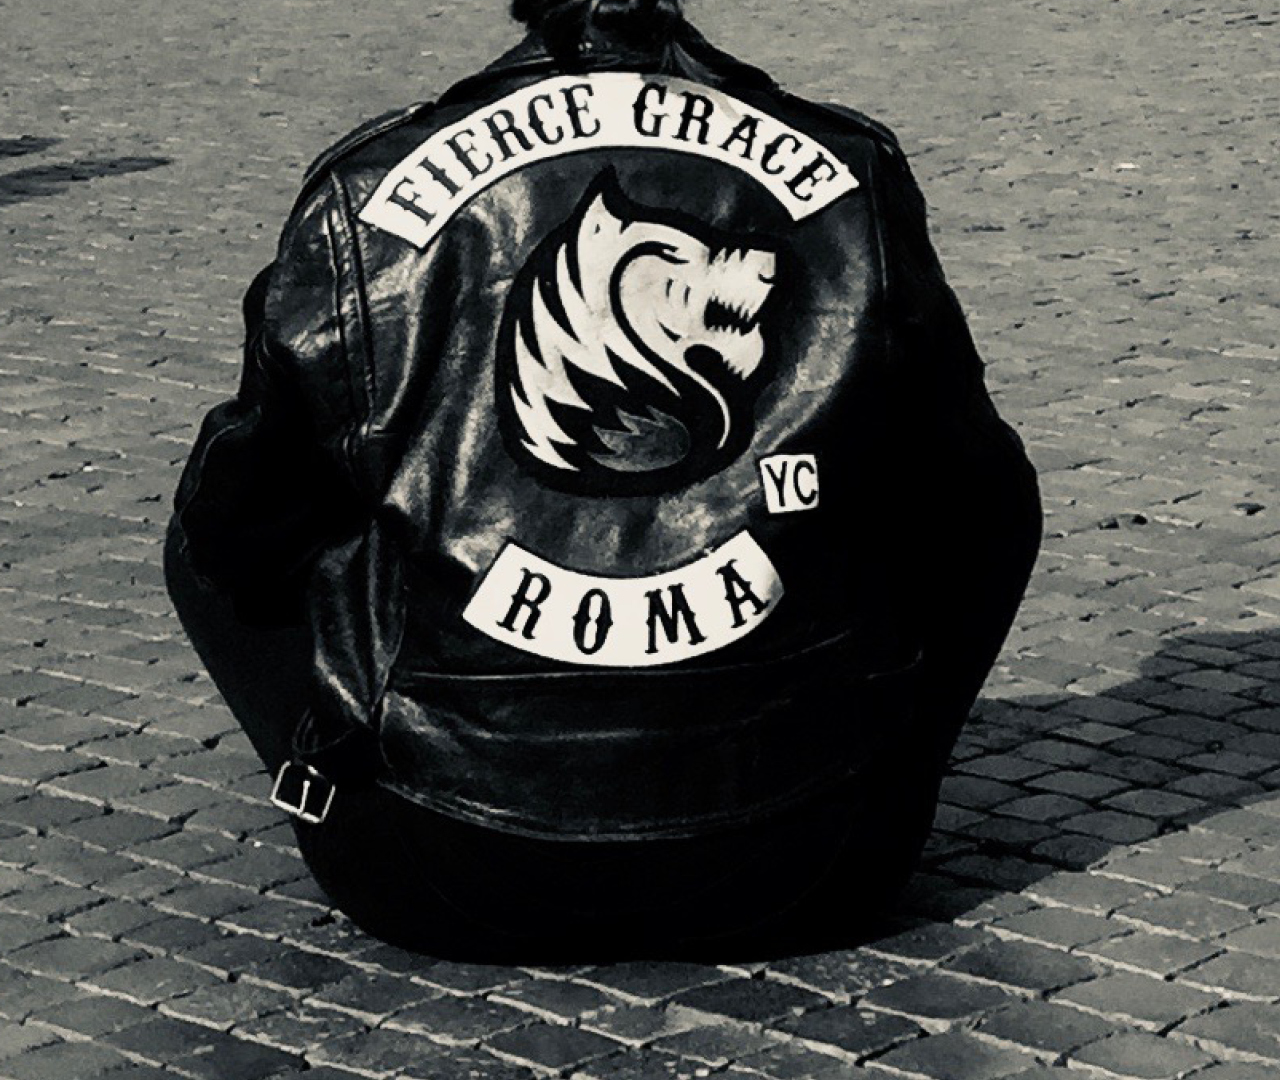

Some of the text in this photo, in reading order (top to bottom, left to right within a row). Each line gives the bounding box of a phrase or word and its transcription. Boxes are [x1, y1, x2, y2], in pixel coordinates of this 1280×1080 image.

[386, 82, 839, 227] FIERCE GRACE
[765, 460, 819, 508] YC
[496, 559, 773, 655] ROMA
